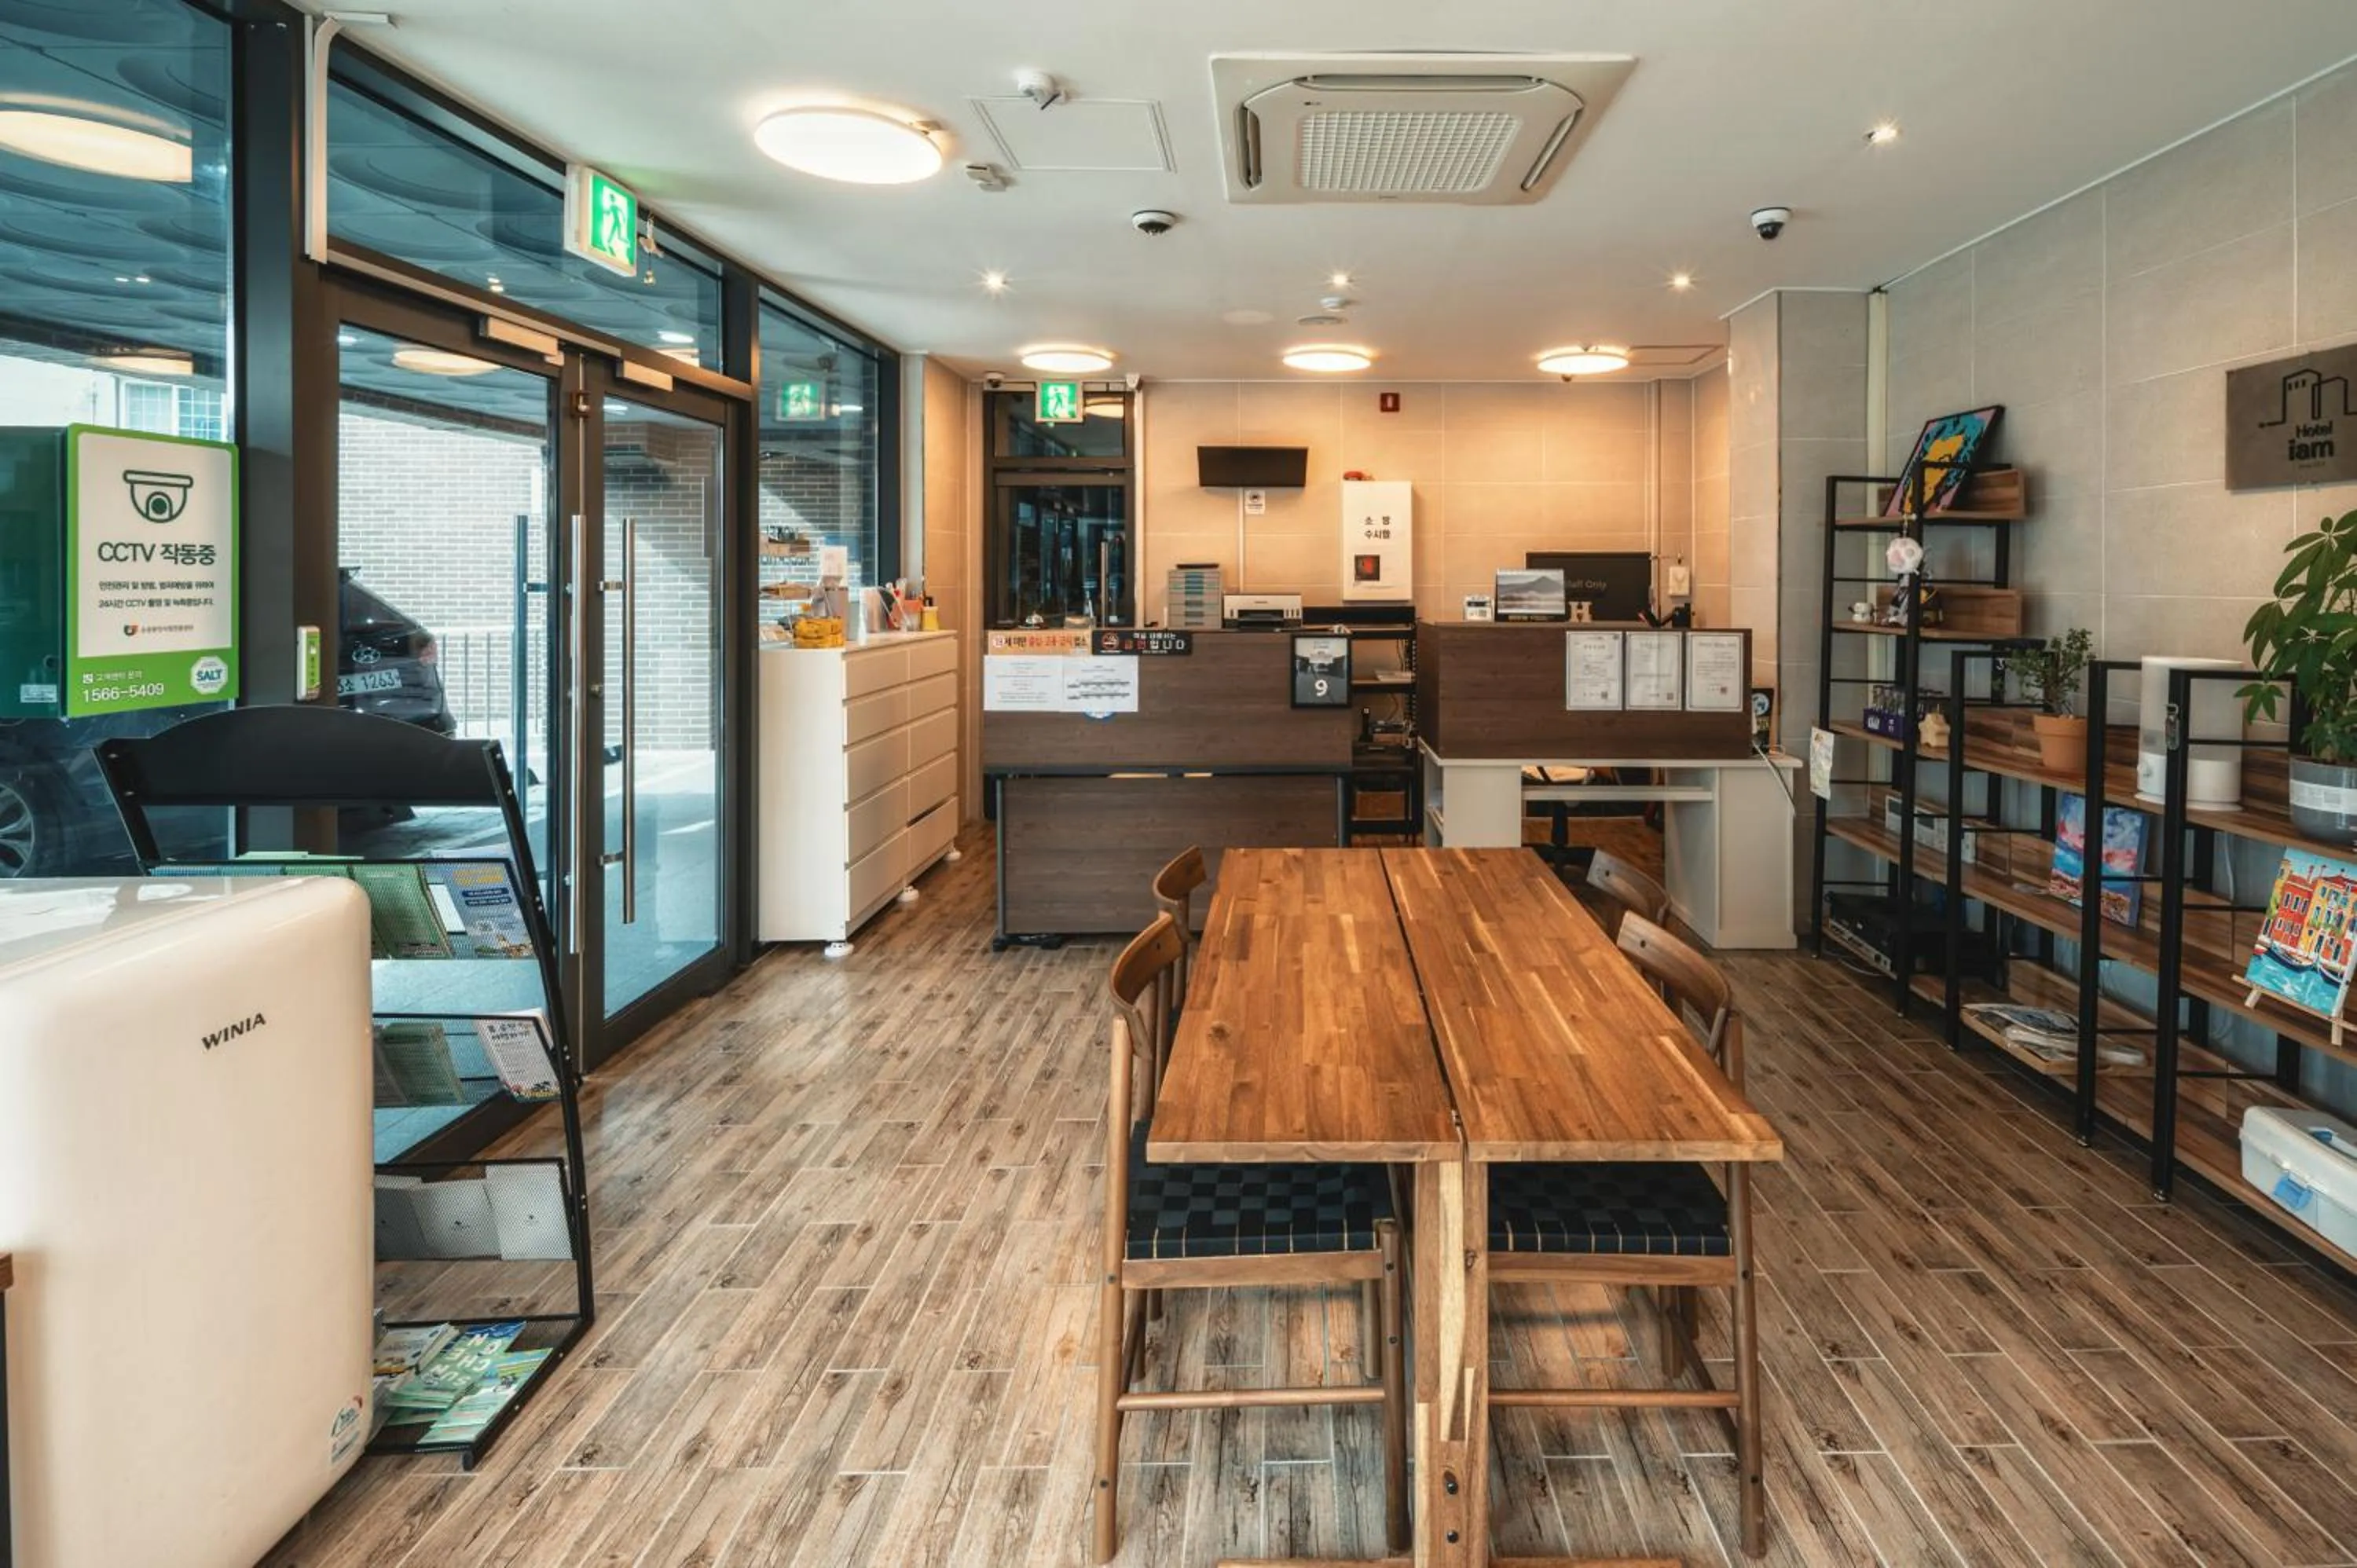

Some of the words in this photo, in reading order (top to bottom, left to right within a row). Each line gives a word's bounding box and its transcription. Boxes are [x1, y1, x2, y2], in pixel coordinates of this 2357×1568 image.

[2295, 420, 2333, 438] Hotel
[2287, 438, 2335, 461] iam
[98, 541, 156, 562] CCTV
[159, 543, 216, 566] 작동중
[196, 669, 222, 682] SALT
[82, 682, 165, 703] 1566-5409
[1314, 679, 1329, 697] 9
[201, 1012, 267, 1050] WINIA
